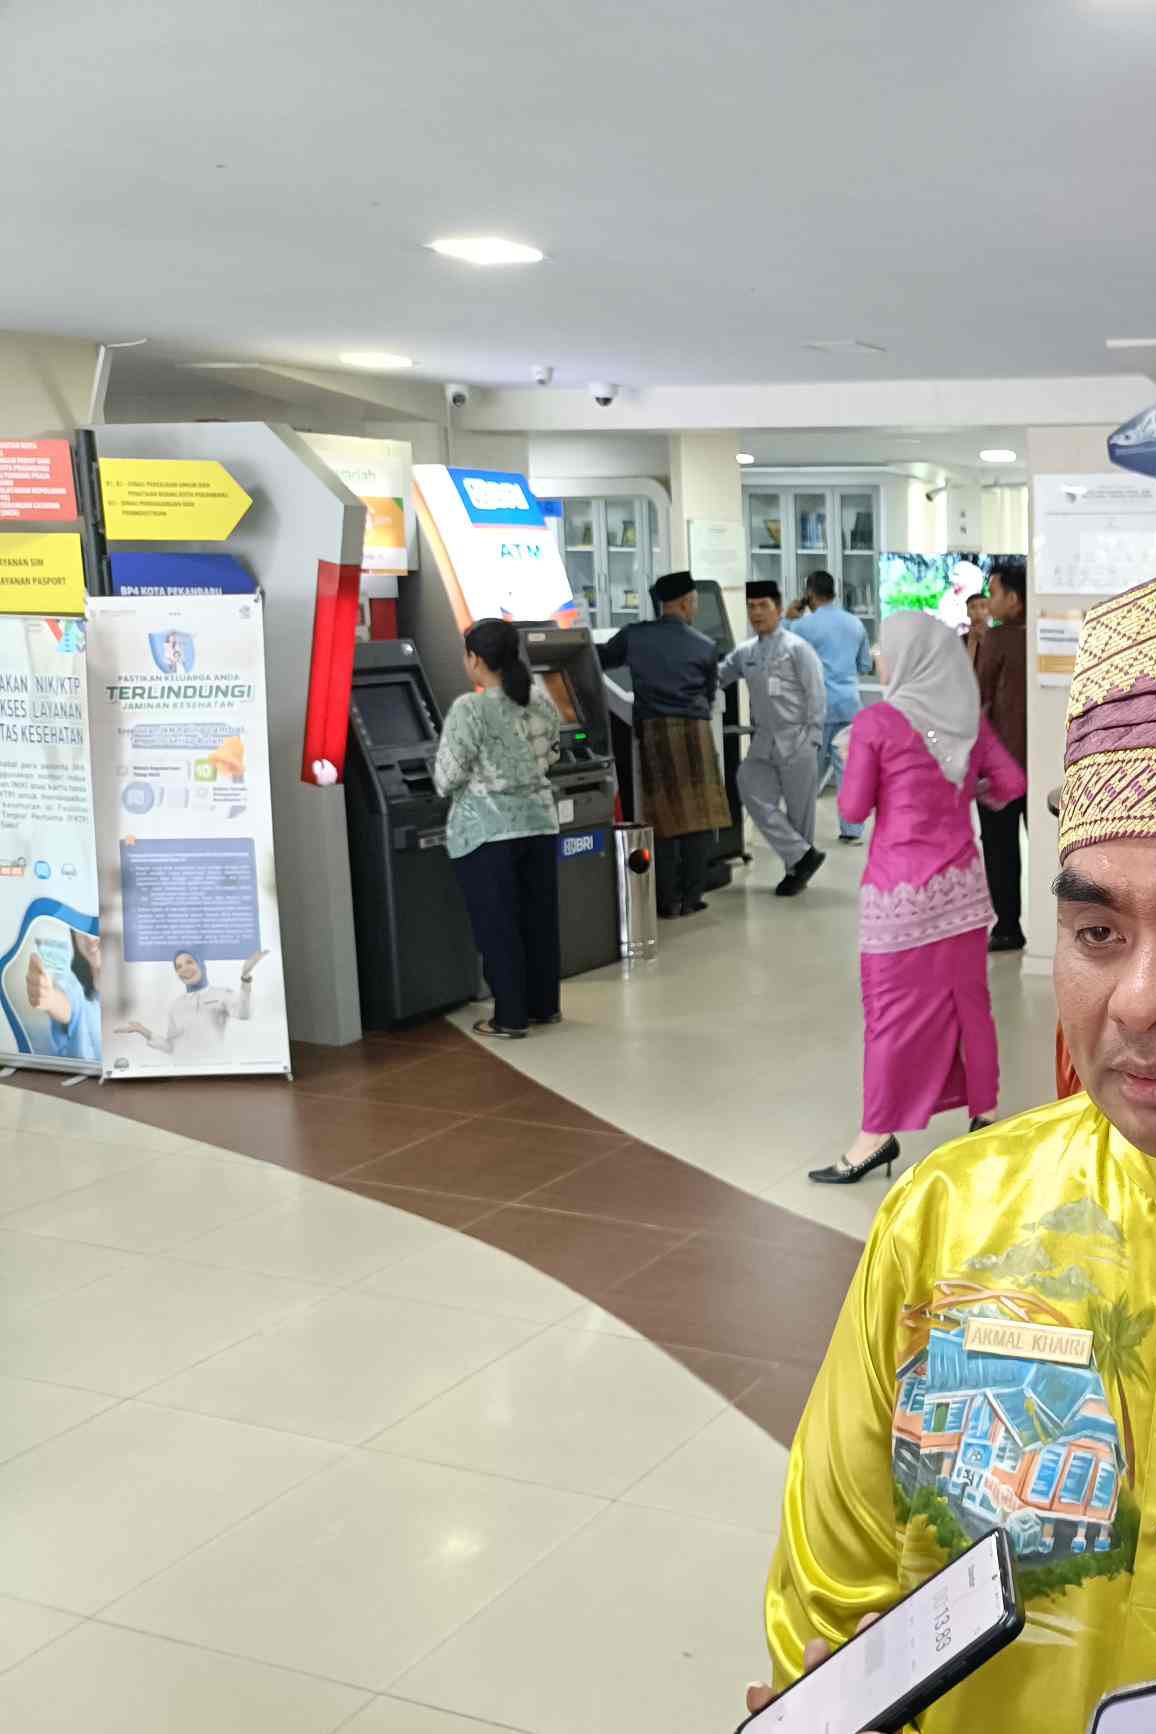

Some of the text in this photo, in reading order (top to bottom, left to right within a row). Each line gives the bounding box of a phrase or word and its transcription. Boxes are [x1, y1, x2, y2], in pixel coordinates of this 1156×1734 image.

[501, 543, 541, 560] ATM
[32, 577, 66, 585] PASPORT
[140, 586, 165, 596] KOTA
[34, 676, 80, 695] NIK/KTP
[118, 673, 240, 683] PASTIKAN KELUARGA ANDA
[106, 684, 251, 700] TERLINDUNGI
[32, 701, 82, 720] LAYANAN
[122, 701, 234, 710] JAMINAN KESEHATAN
[21, 725, 83, 744] KESEHATAN
[972, 1326, 1087, 1357] AKMAL KHAIRI
